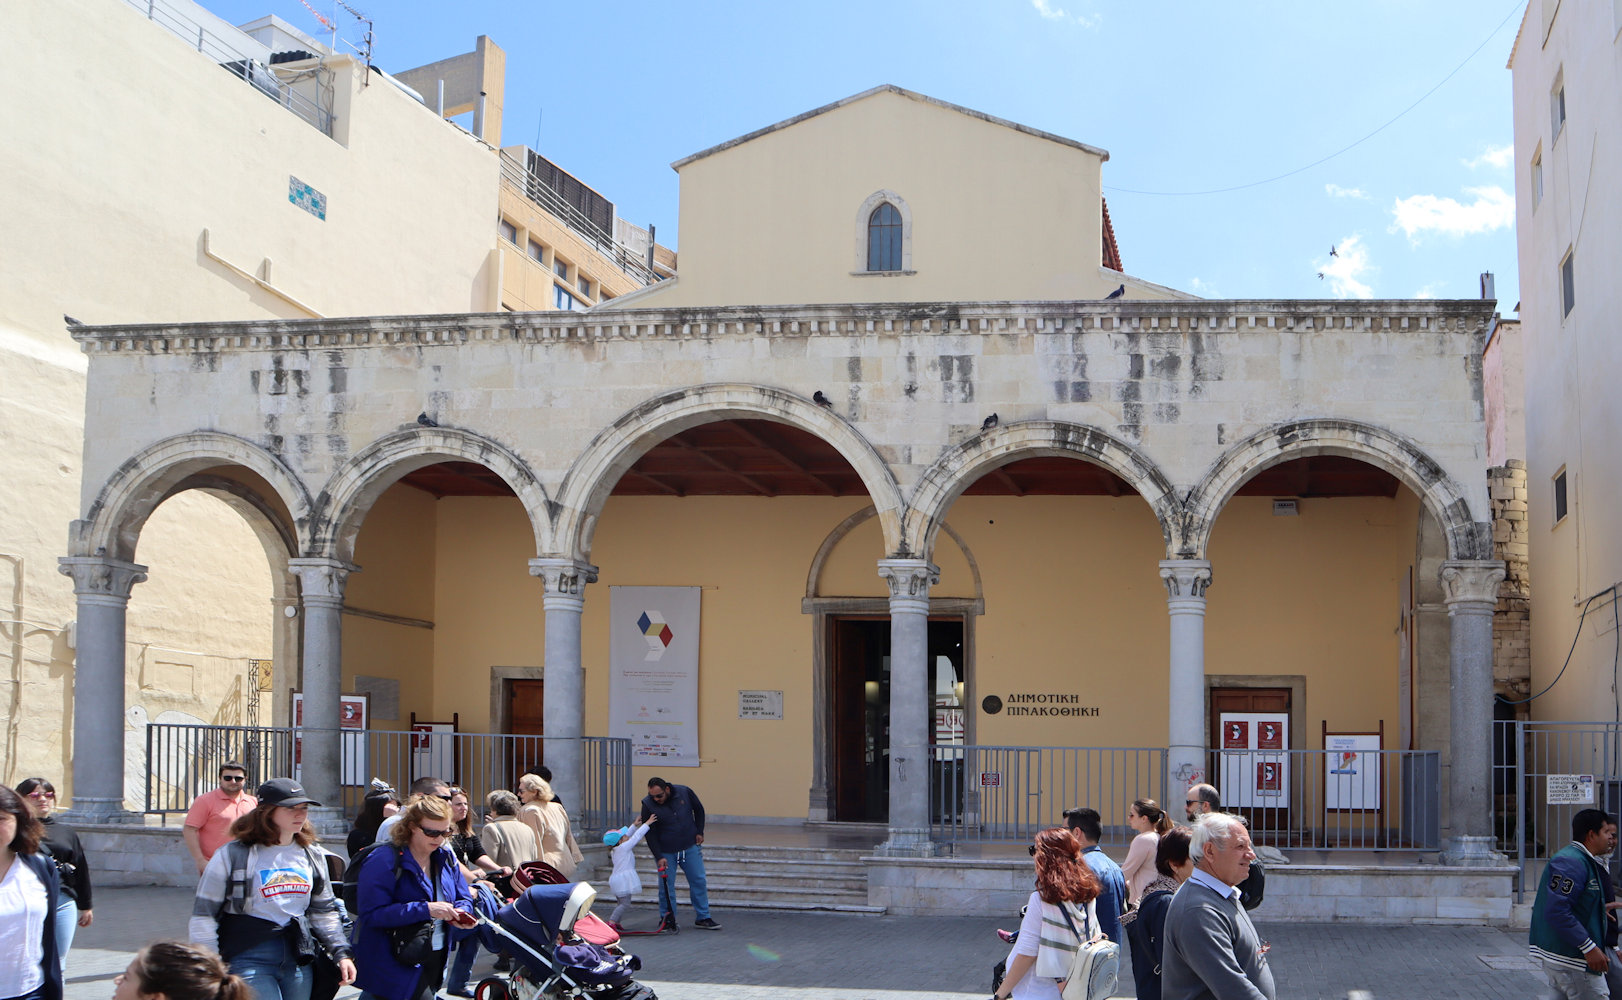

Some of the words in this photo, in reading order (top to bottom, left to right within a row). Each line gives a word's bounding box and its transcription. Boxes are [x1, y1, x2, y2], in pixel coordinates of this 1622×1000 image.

[1007, 693, 1079, 703] ΔΗΜΟΤΙΚΗ
[1007, 706, 1100, 716] ΠΙΝΑΚΟΘΗΚΗ
[1550, 873, 1575, 895] 53
[263, 884, 308, 896] KILIMANJARO
